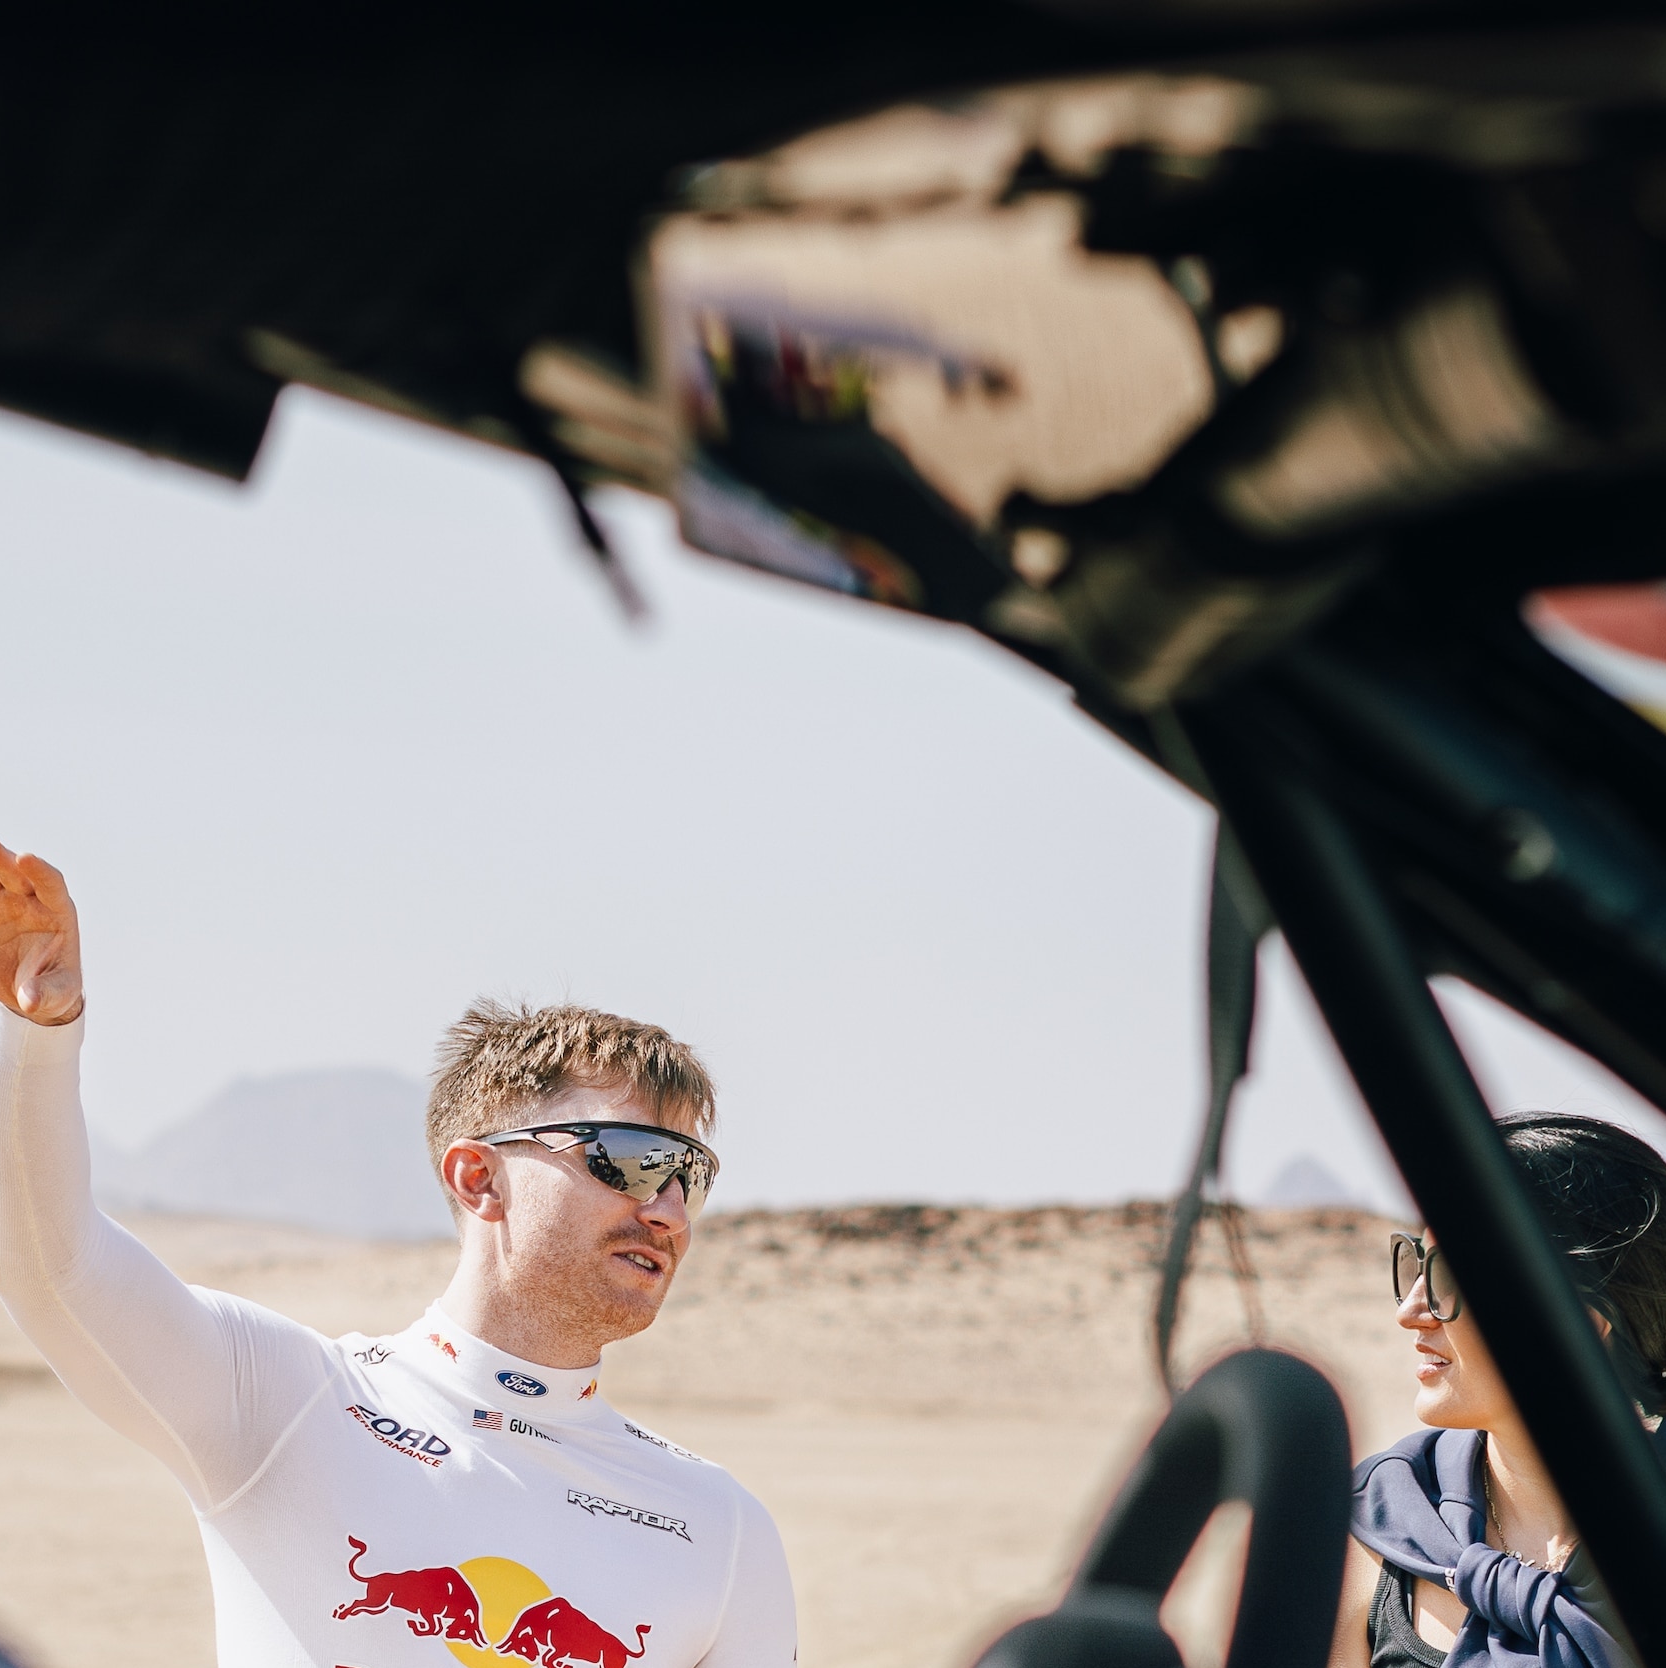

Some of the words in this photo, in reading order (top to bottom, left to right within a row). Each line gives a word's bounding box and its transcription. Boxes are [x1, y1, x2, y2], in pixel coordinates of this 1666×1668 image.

[504, 1375, 540, 1395] Ford
[345, 1406, 443, 1468] PERFORMANCE
[567, 1489, 694, 1544] RAPTOR
